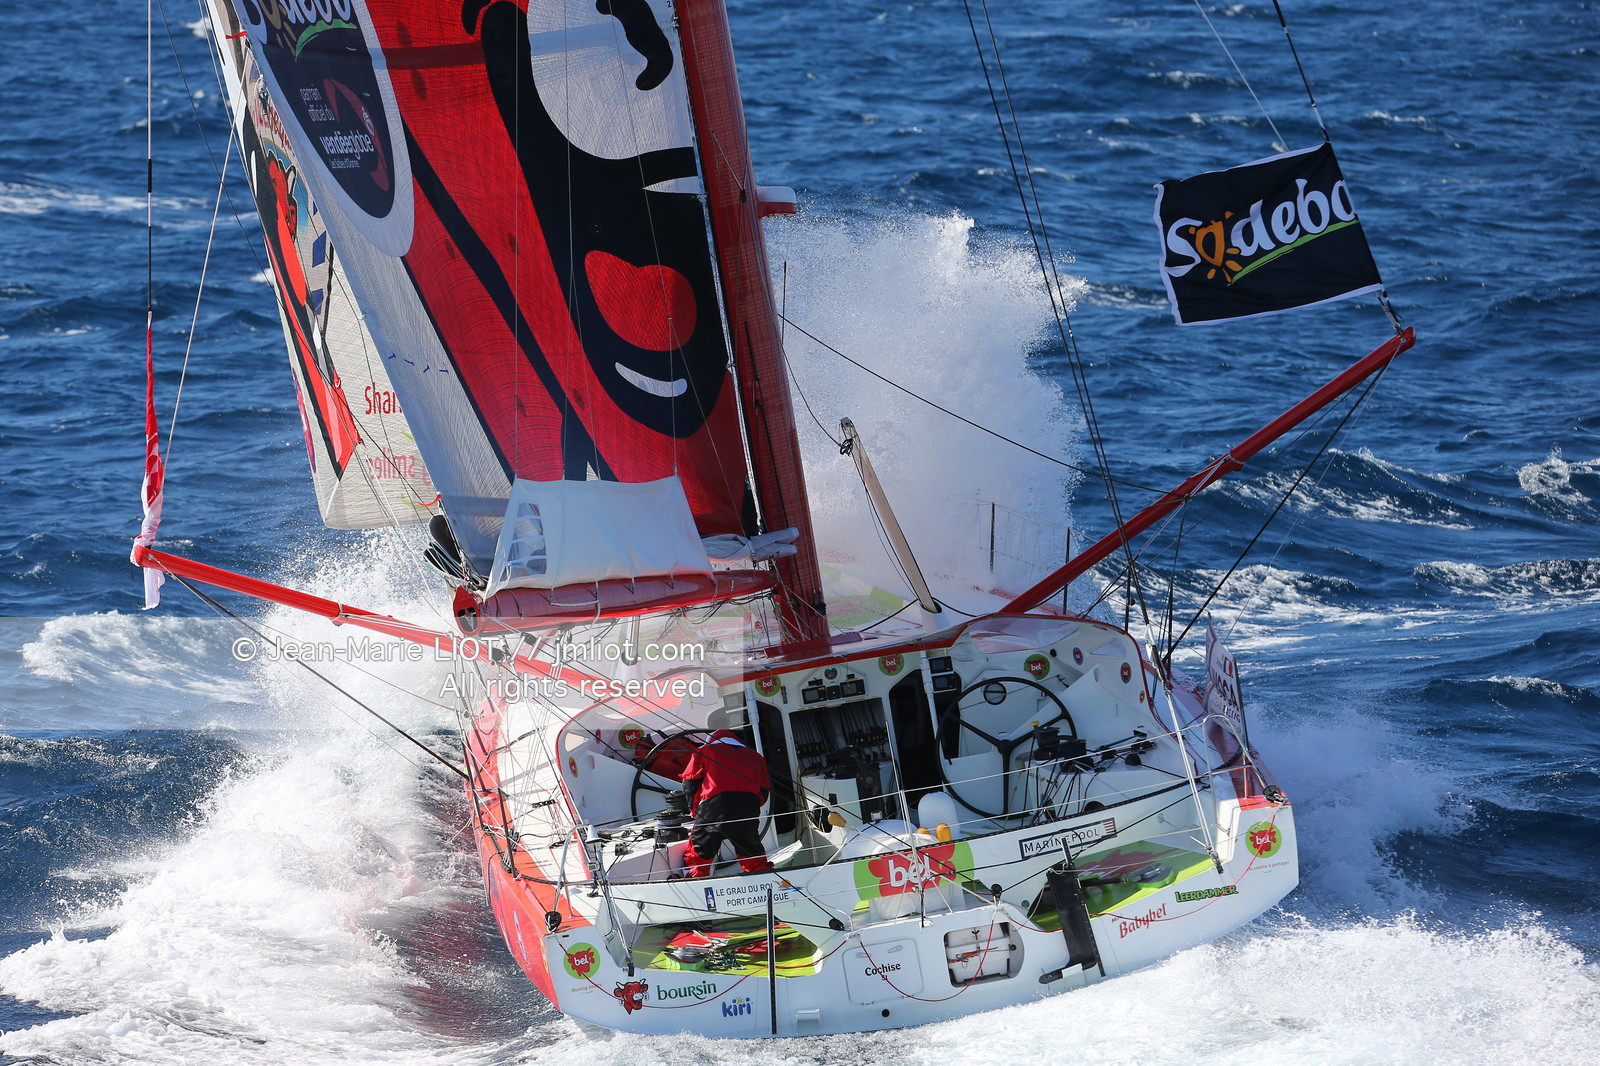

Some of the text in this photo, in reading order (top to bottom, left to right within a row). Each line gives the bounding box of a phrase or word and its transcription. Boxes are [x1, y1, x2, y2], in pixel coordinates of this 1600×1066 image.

[625, 732, 637, 741] bel
[888, 853, 936, 888] bel
[715, 888, 725, 897] LE
[726, 886, 747, 896] GRAU
[748, 884, 759, 894] DU
[1175, 885, 1239, 903] LEERDAMMER
[726, 892, 790, 908] PORT CAMAGUE
[1119, 902, 1168, 940] Babybel
[573, 954, 590, 967] bel
[864, 963, 902, 977] Cochise
[656, 980, 717, 1001] boursin
[721, 997, 752, 1018] kiri
